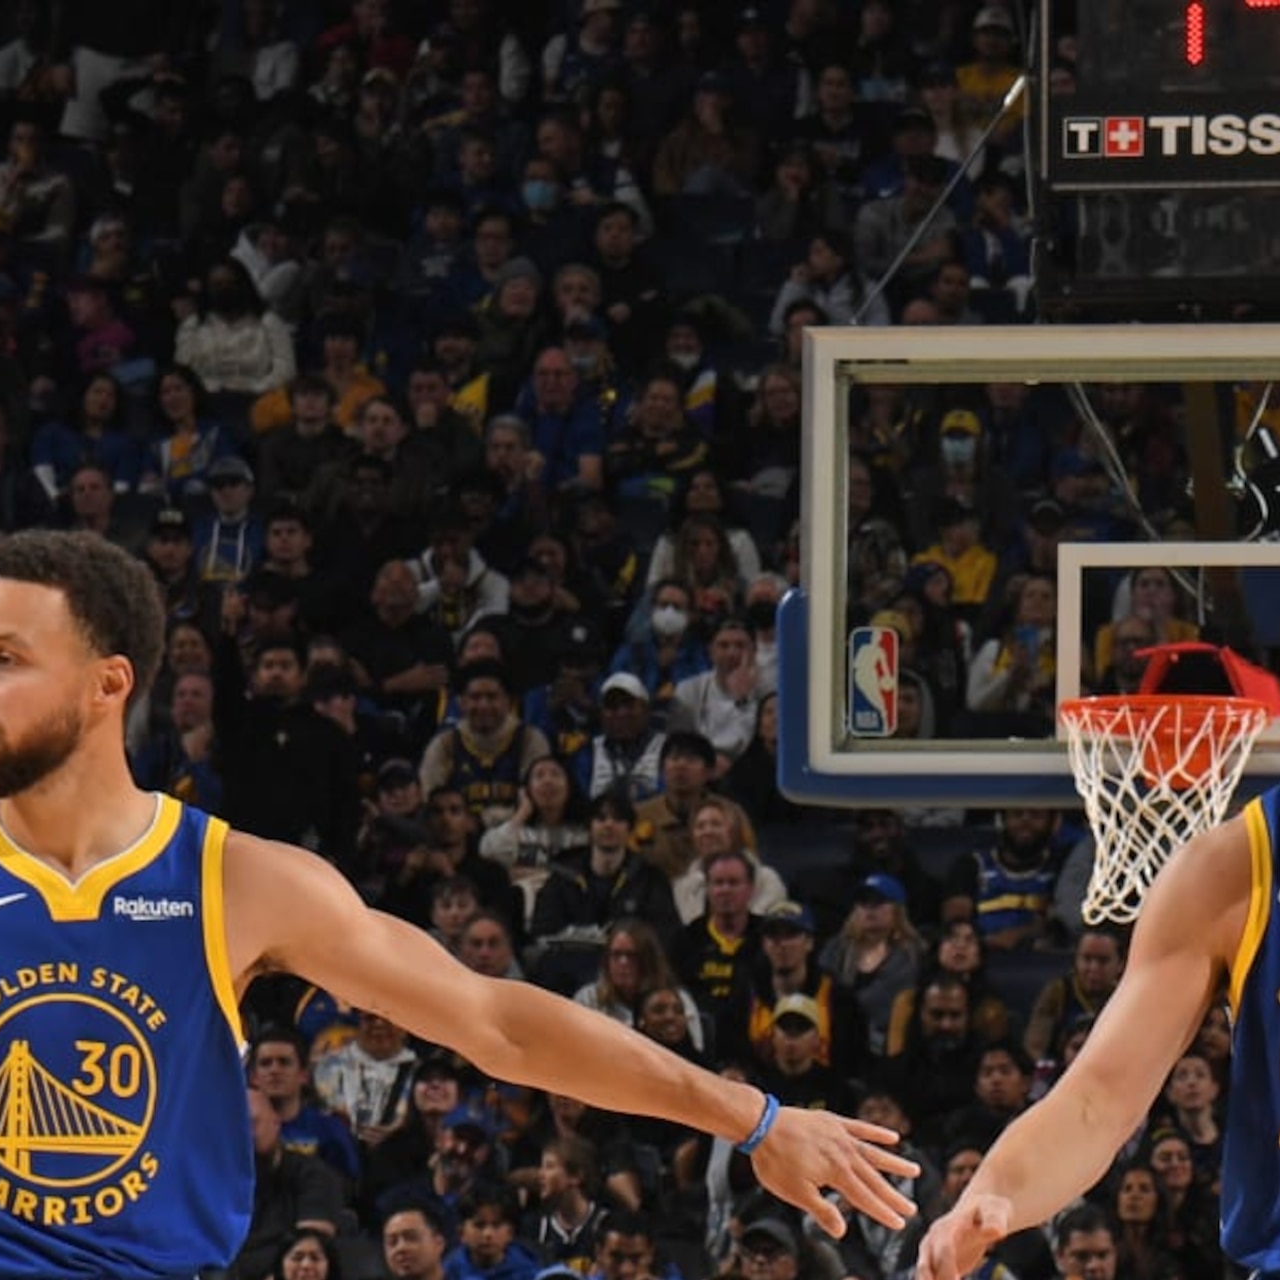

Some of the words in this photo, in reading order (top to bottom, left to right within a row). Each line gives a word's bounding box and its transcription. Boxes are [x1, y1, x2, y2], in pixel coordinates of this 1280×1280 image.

[113, 897, 193, 919] Rakuten
[90, 967, 167, 1031] STATE
[72, 1040, 141, 1098] 30
